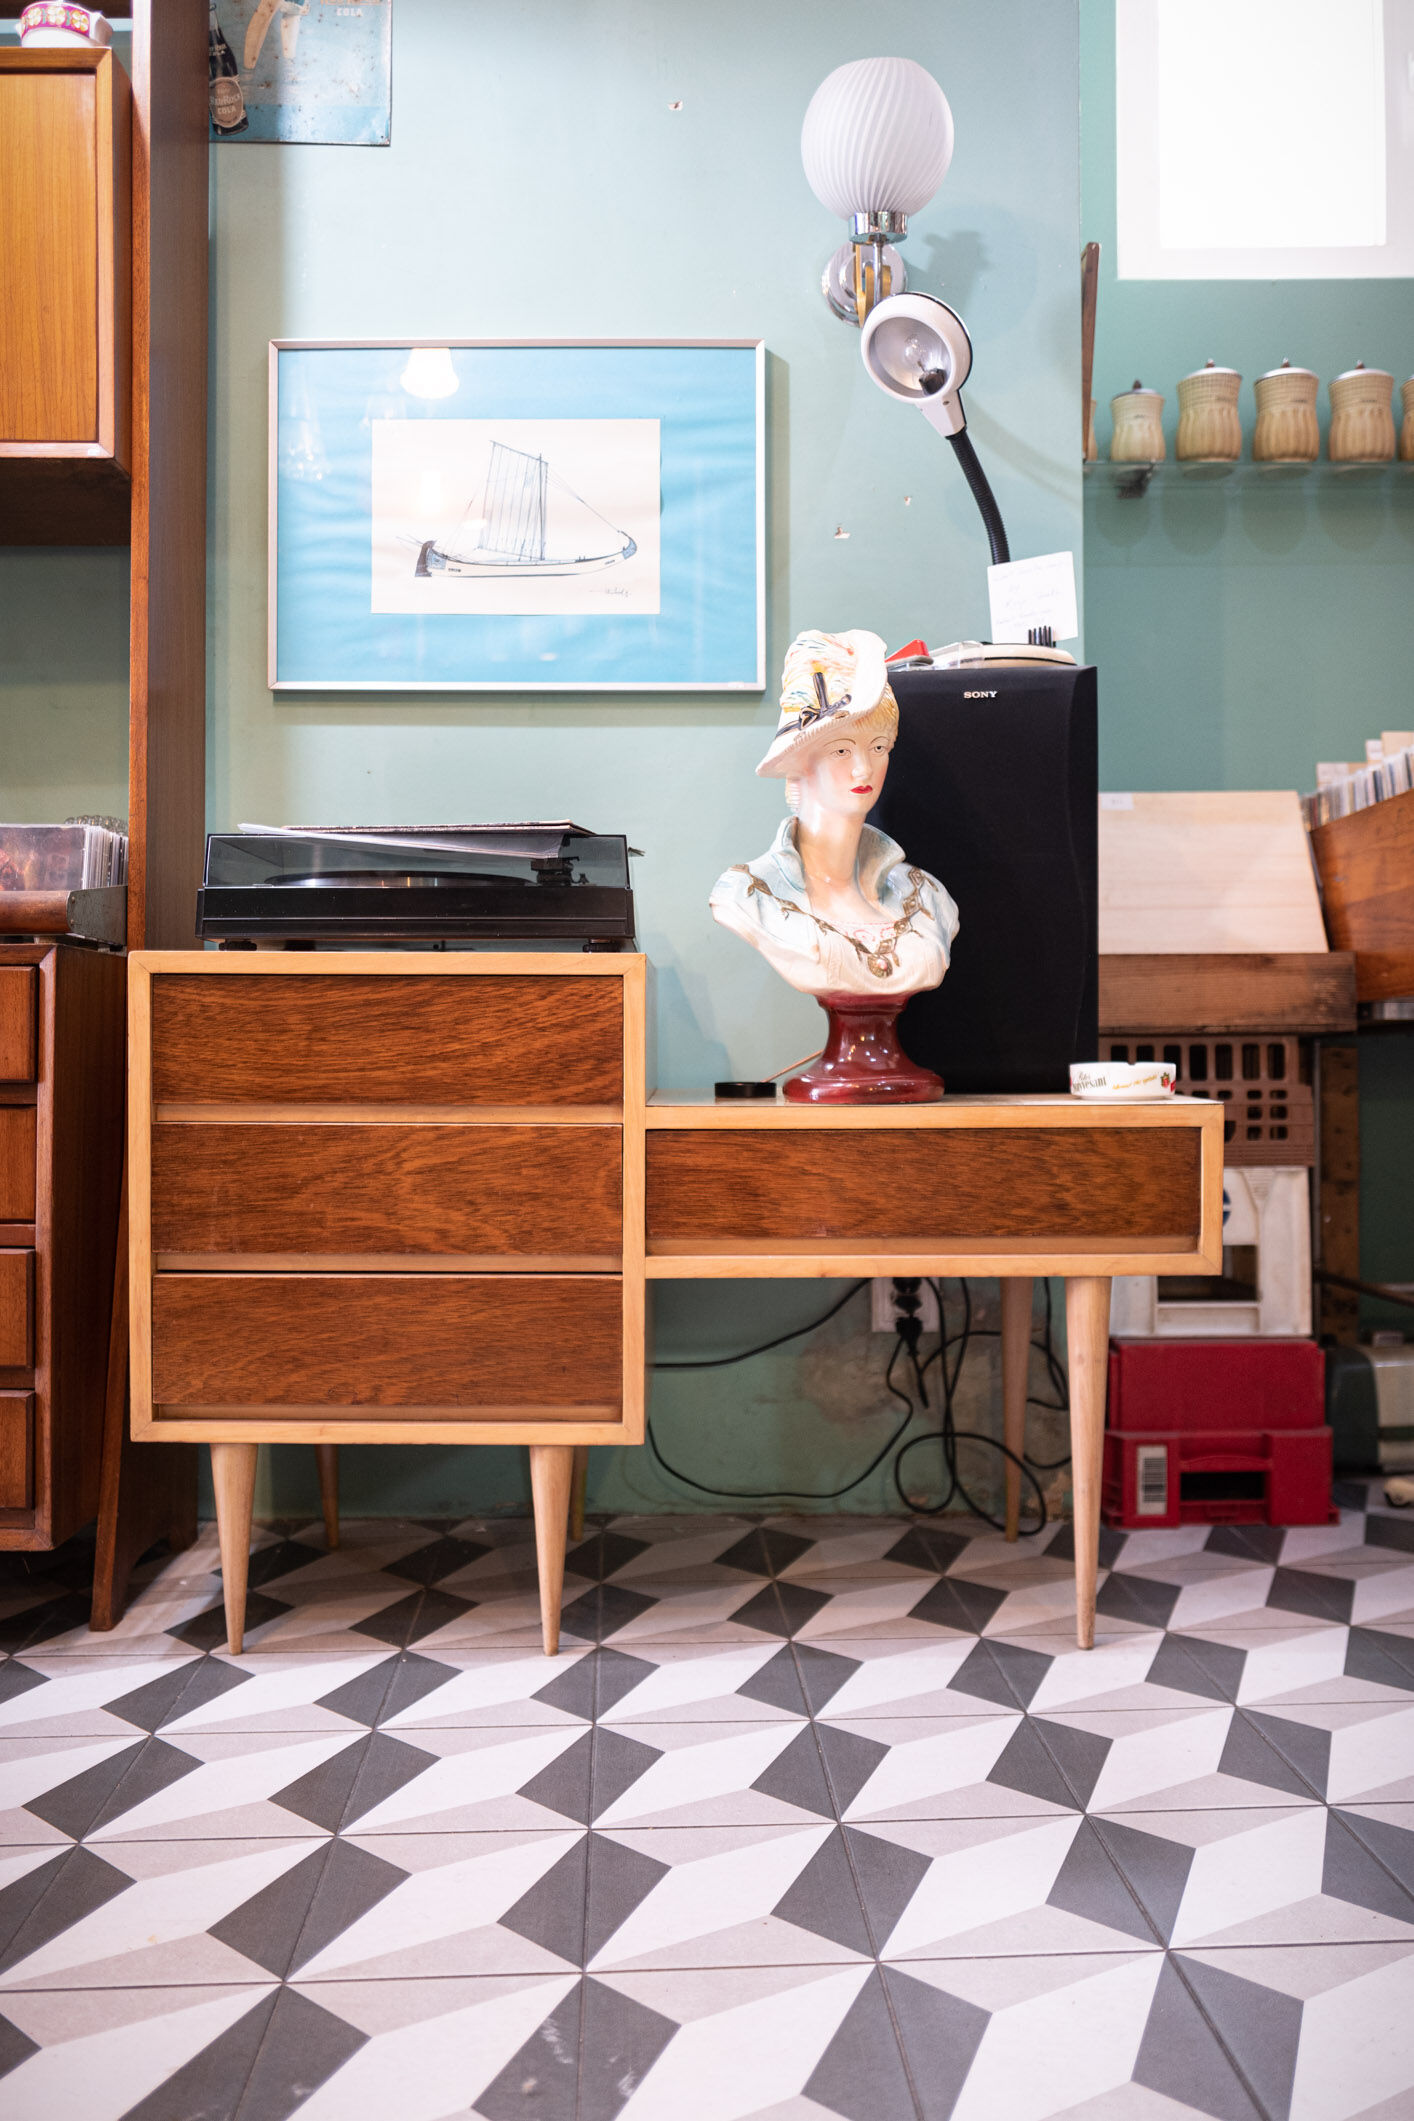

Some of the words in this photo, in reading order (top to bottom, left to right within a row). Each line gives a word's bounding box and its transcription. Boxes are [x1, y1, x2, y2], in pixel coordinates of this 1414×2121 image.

[336, 7, 363, 17] COLA
[217, 104, 237, 115] COLA
[963, 690, 998, 699] SONY
